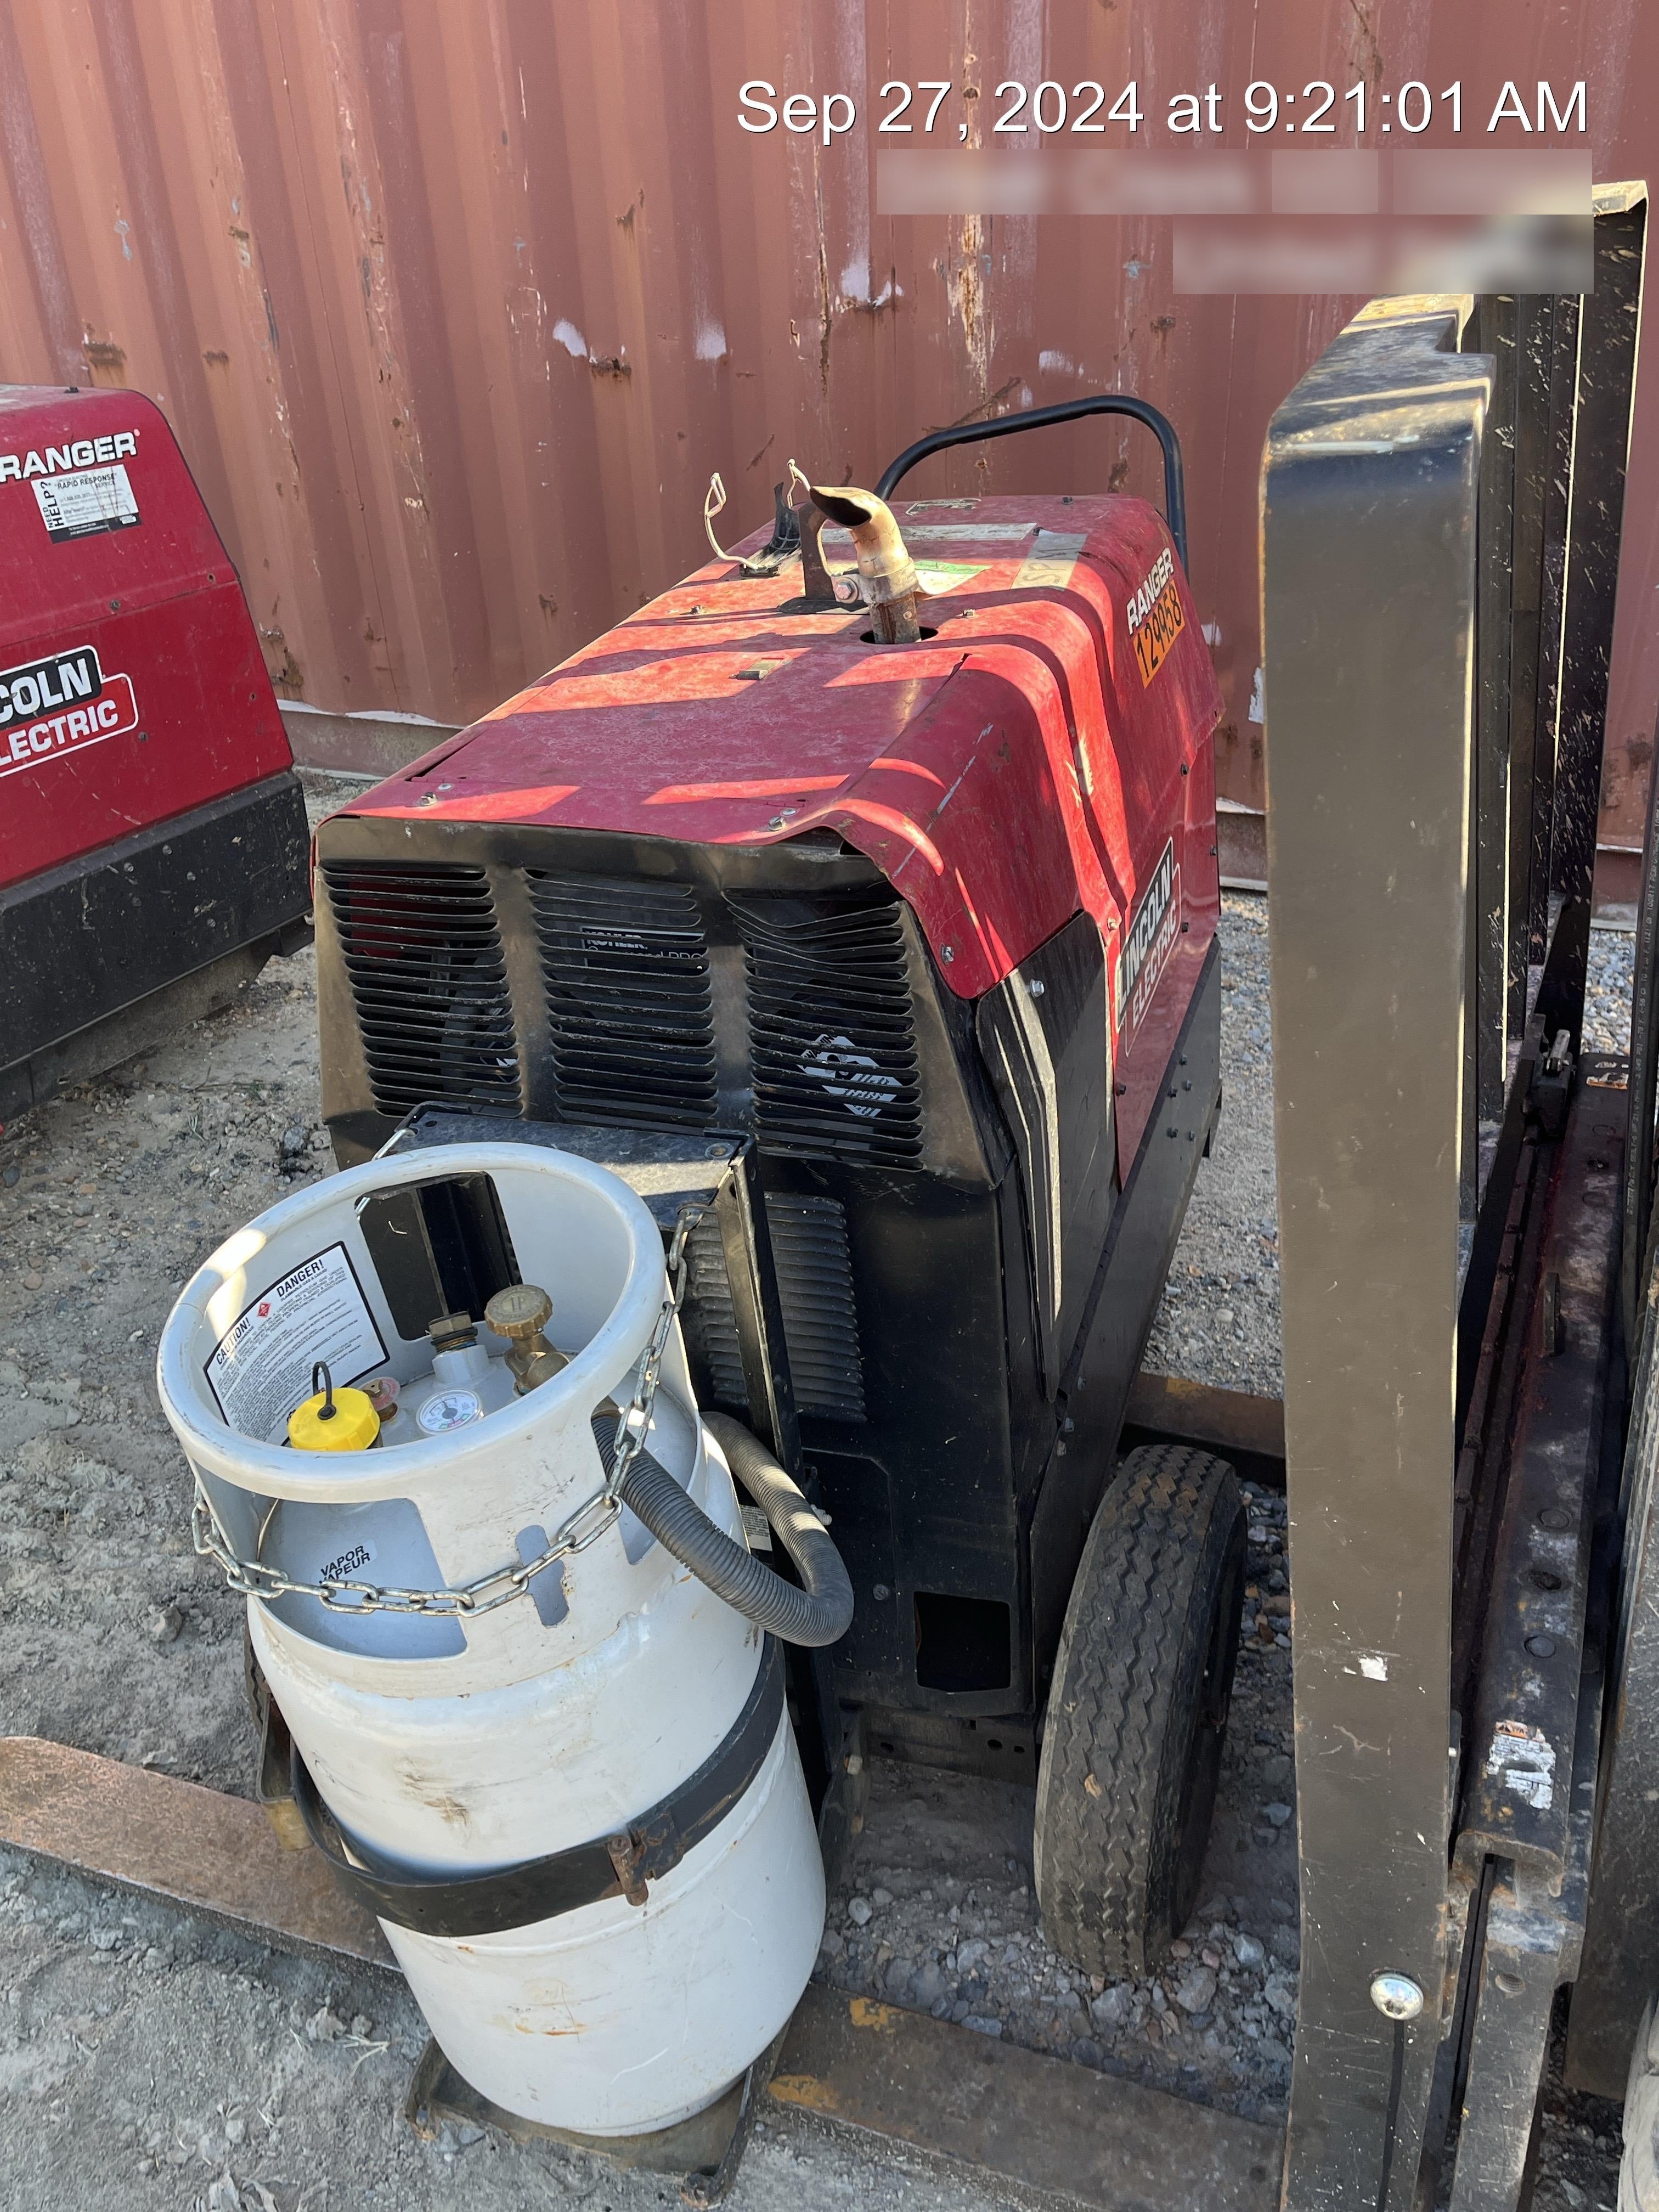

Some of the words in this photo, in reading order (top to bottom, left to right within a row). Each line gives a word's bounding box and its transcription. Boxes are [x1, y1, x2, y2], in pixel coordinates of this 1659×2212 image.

[0, 431, 137, 483] RANGER
[58, 480, 78, 489] RAPID
[80, 473, 115, 486] RESPONSE
[40, 481, 64, 527] HELP?
[43, 507, 54, 528] NEED
[1126, 547, 1174, 635] RANGER
[1137, 583, 1182, 679] 129958
[1119, 854, 1171, 1013] LINCOLN
[1132, 900, 1176, 1030] ELECTRIC
[276, 1259, 324, 1297] DANGER!
[216, 1317, 252, 1365] CAUTION!
[320, 1545, 364, 1576] VAPOR
